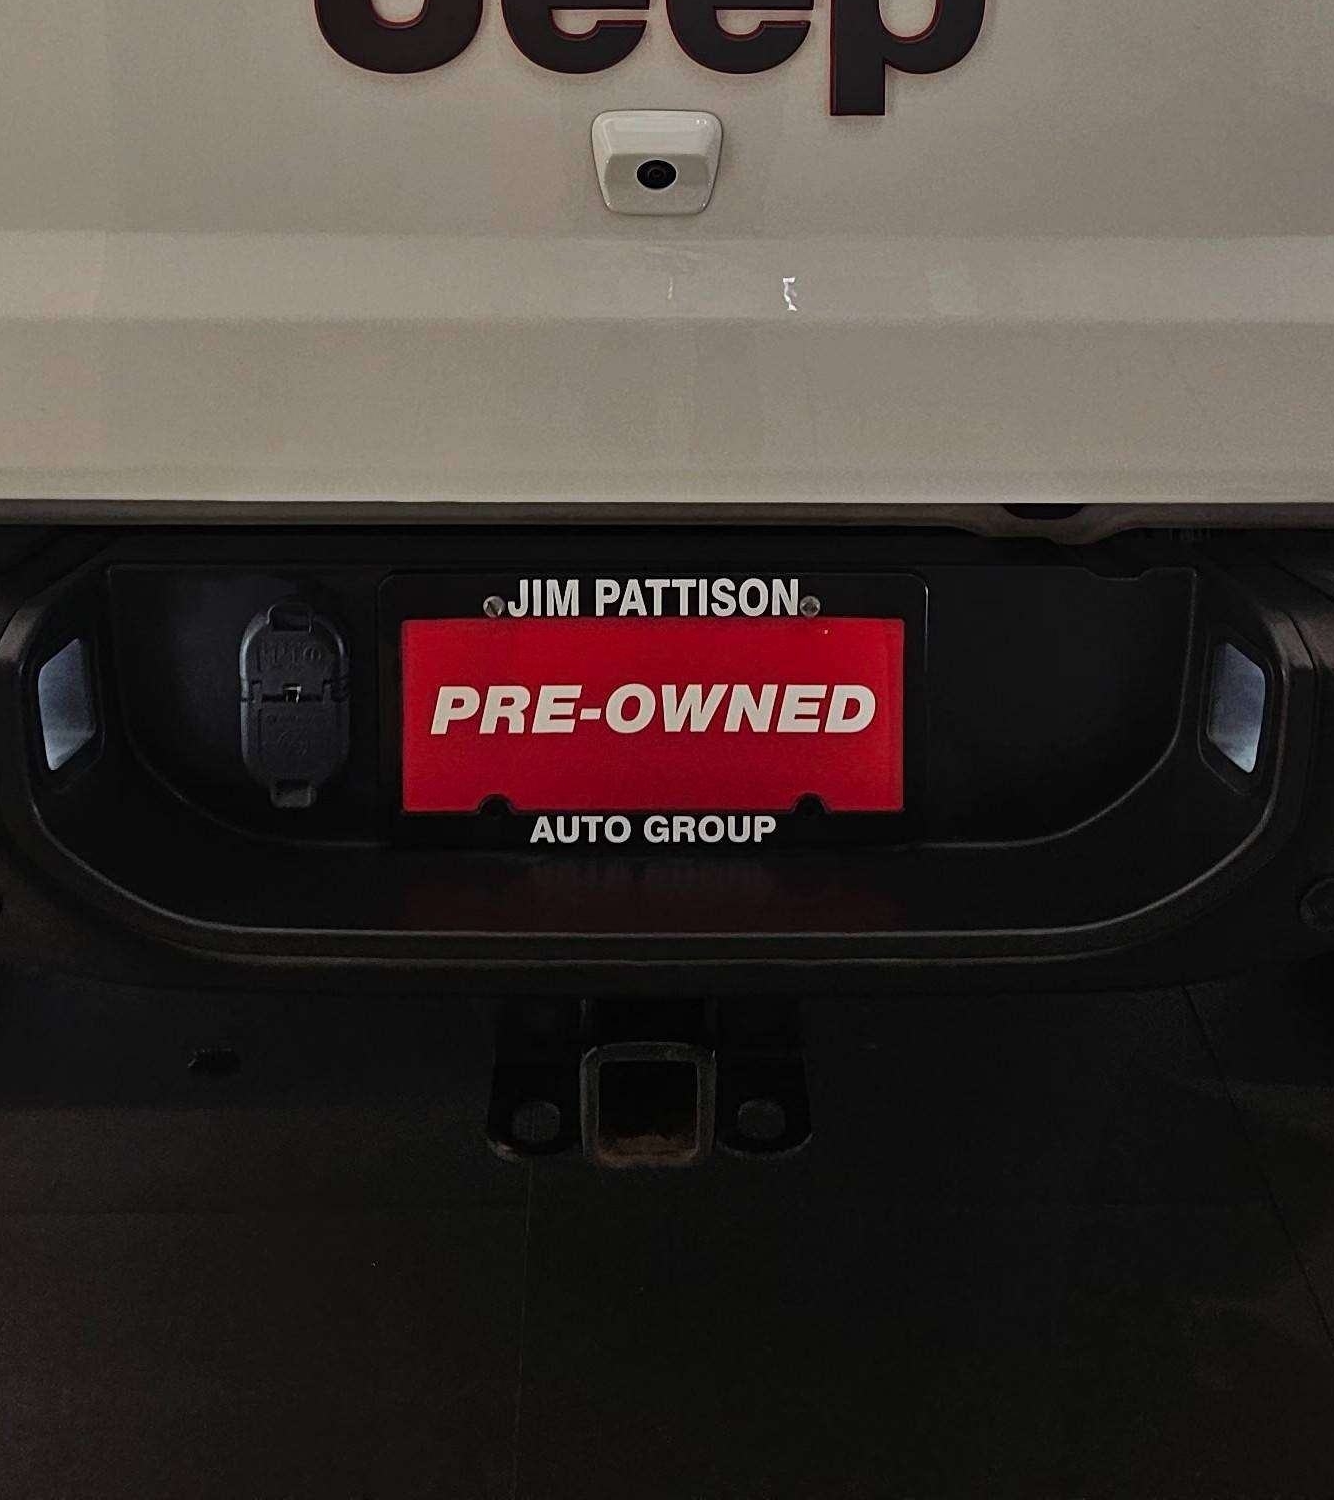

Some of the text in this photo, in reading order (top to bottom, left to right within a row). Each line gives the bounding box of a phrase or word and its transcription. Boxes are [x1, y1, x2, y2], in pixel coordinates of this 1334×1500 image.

[507, 578, 799, 617] JIM PATTISON
[430, 683, 876, 735] PRE-OWNED
[530, 815, 777, 844] AUTO GROUP
